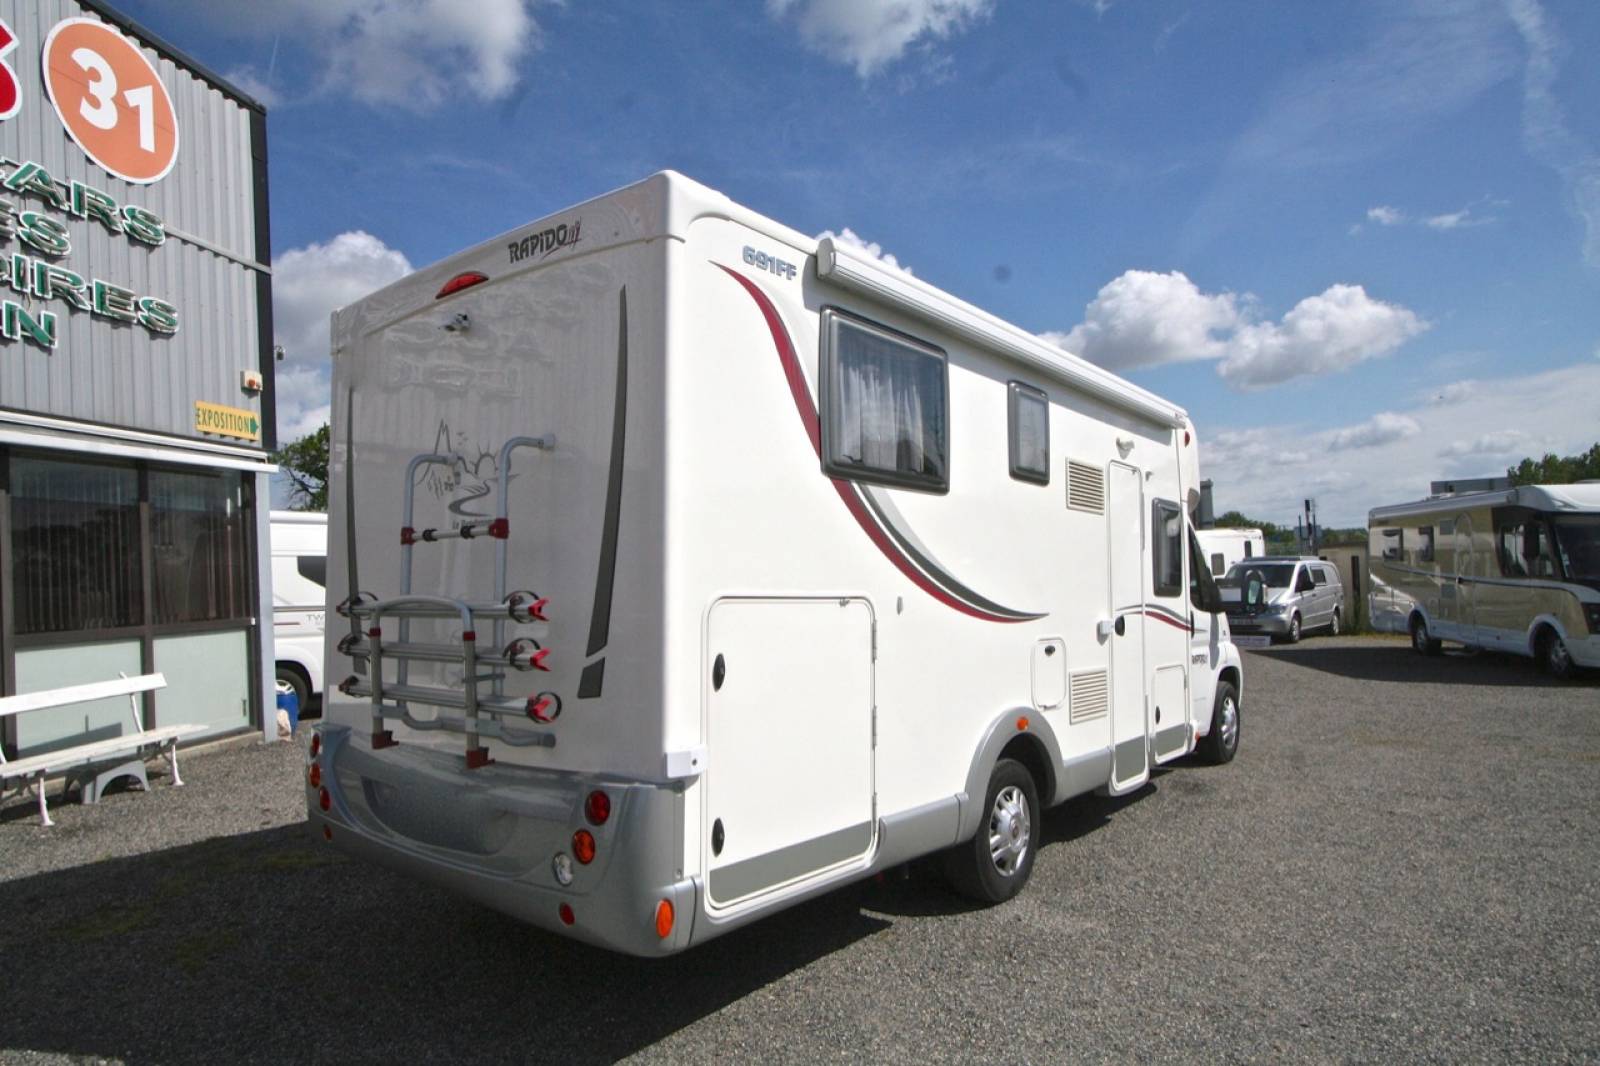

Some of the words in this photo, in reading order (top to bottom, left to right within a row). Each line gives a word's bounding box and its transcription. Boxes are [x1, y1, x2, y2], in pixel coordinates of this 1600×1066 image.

[71, 47, 155, 153] 31
[0, 158, 166, 246] ARS
[508, 223, 567, 264] RAPIDO
[0, 253, 180, 334] IRES
[196, 407, 250, 433] EXPOSITION
